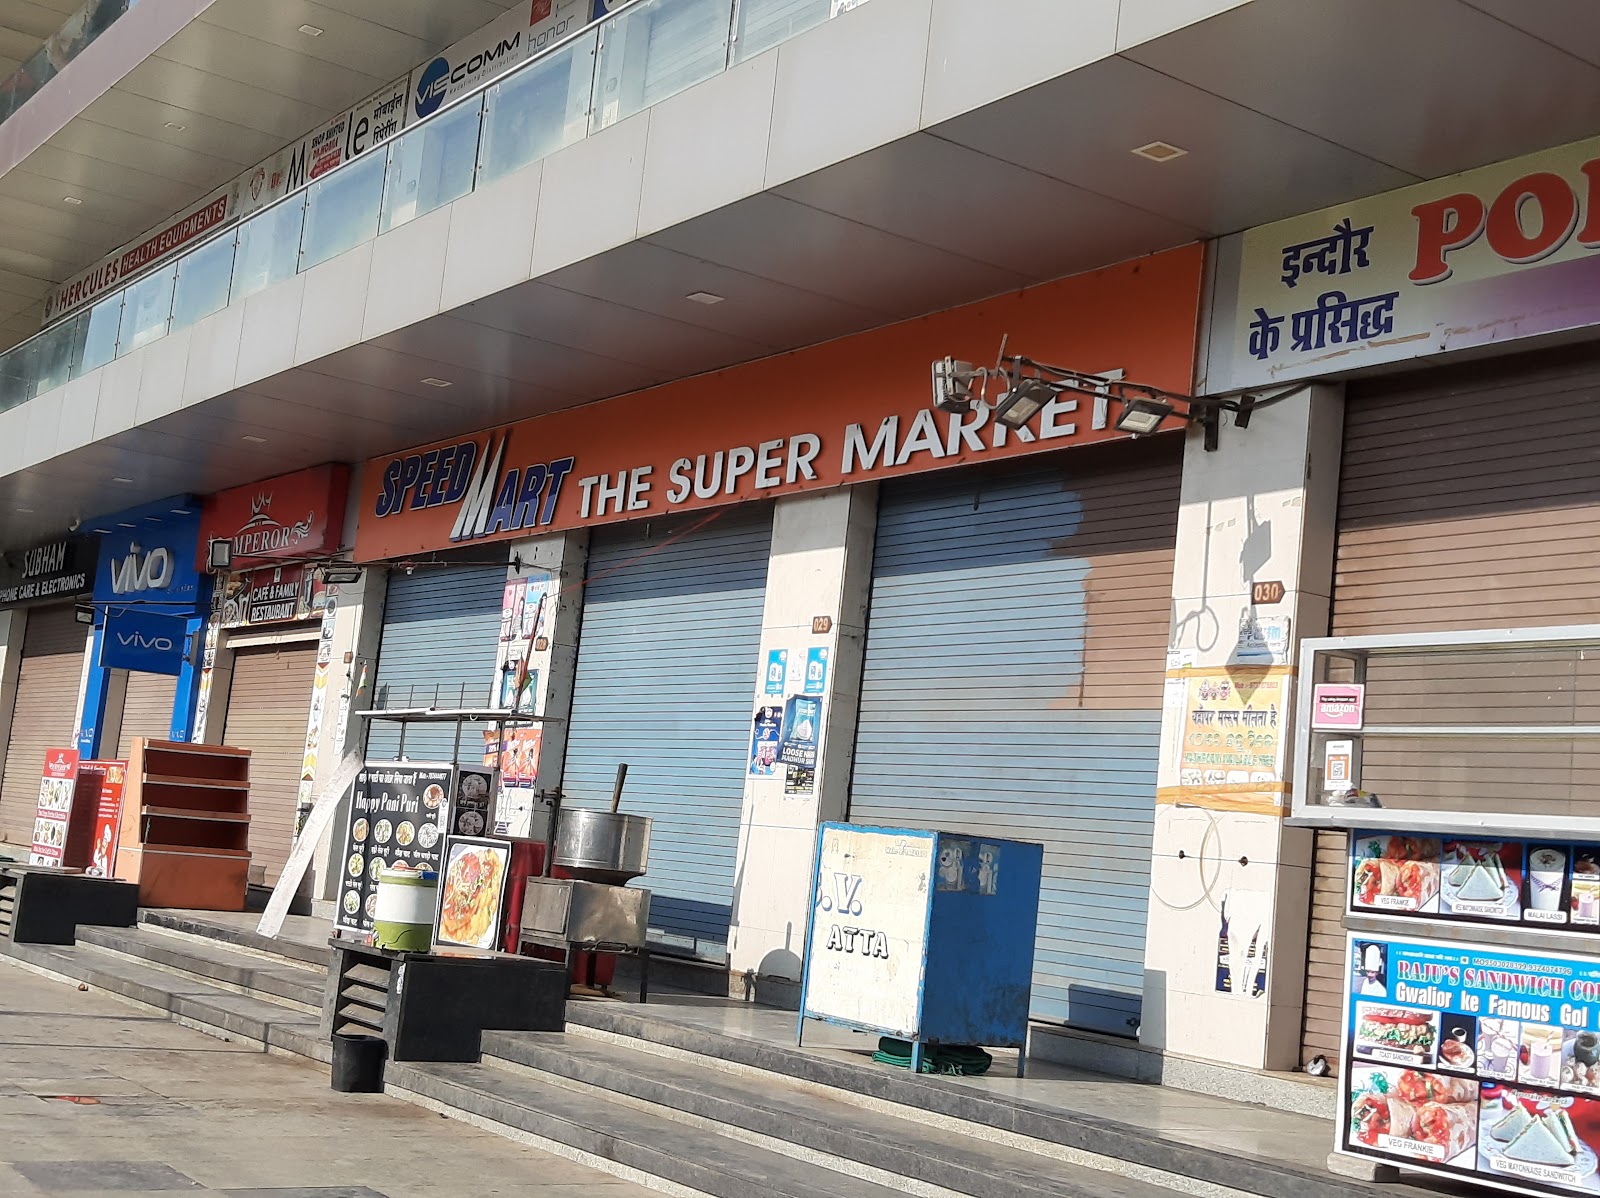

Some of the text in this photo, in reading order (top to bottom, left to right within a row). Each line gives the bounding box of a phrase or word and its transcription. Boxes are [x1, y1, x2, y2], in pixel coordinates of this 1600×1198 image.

[527, 14, 575, 53] honor
[59, 257, 119, 312] HERCULES
[122, 240, 158, 272] HEALTH
[158, 199, 225, 252] EQUIPMENTS
[1281, 218, 1375, 288] इन्दौर
[1249, 290, 1400, 360] के प्रसिद्ध
[374, 430, 575, 542] SPEED MART
[577, 465, 653, 519] THE
[665, 432, 822, 505] SUPER
[22, 541, 67, 579] SUBHAM
[19, 584, 35, 599] CARE
[35, 582, 40, 597] &
[41, 572, 86, 596] ELECTRONICS
[269, 585, 275, 599] &
[275, 582, 300, 598] FAMILY
[1254, 584, 1279, 601] 030
[251, 603, 295, 622] RESTAURANT
[814, 617, 829, 632] 029
[116, 630, 173, 651] vivo
[1321, 704, 1355, 713] amazon
[355, 791, 420, 814] Happy Pani Puri
[826, 924, 889, 959] ATTA
[1396, 960, 1600, 1004] RAJU'S SANDWICH CO
[1395, 981, 1589, 1028] Gwalior ke Famous Gol
[1388, 1137, 1434, 1155] VEG FRANKIE
[1496, 1159, 1507, 1169] VEG
